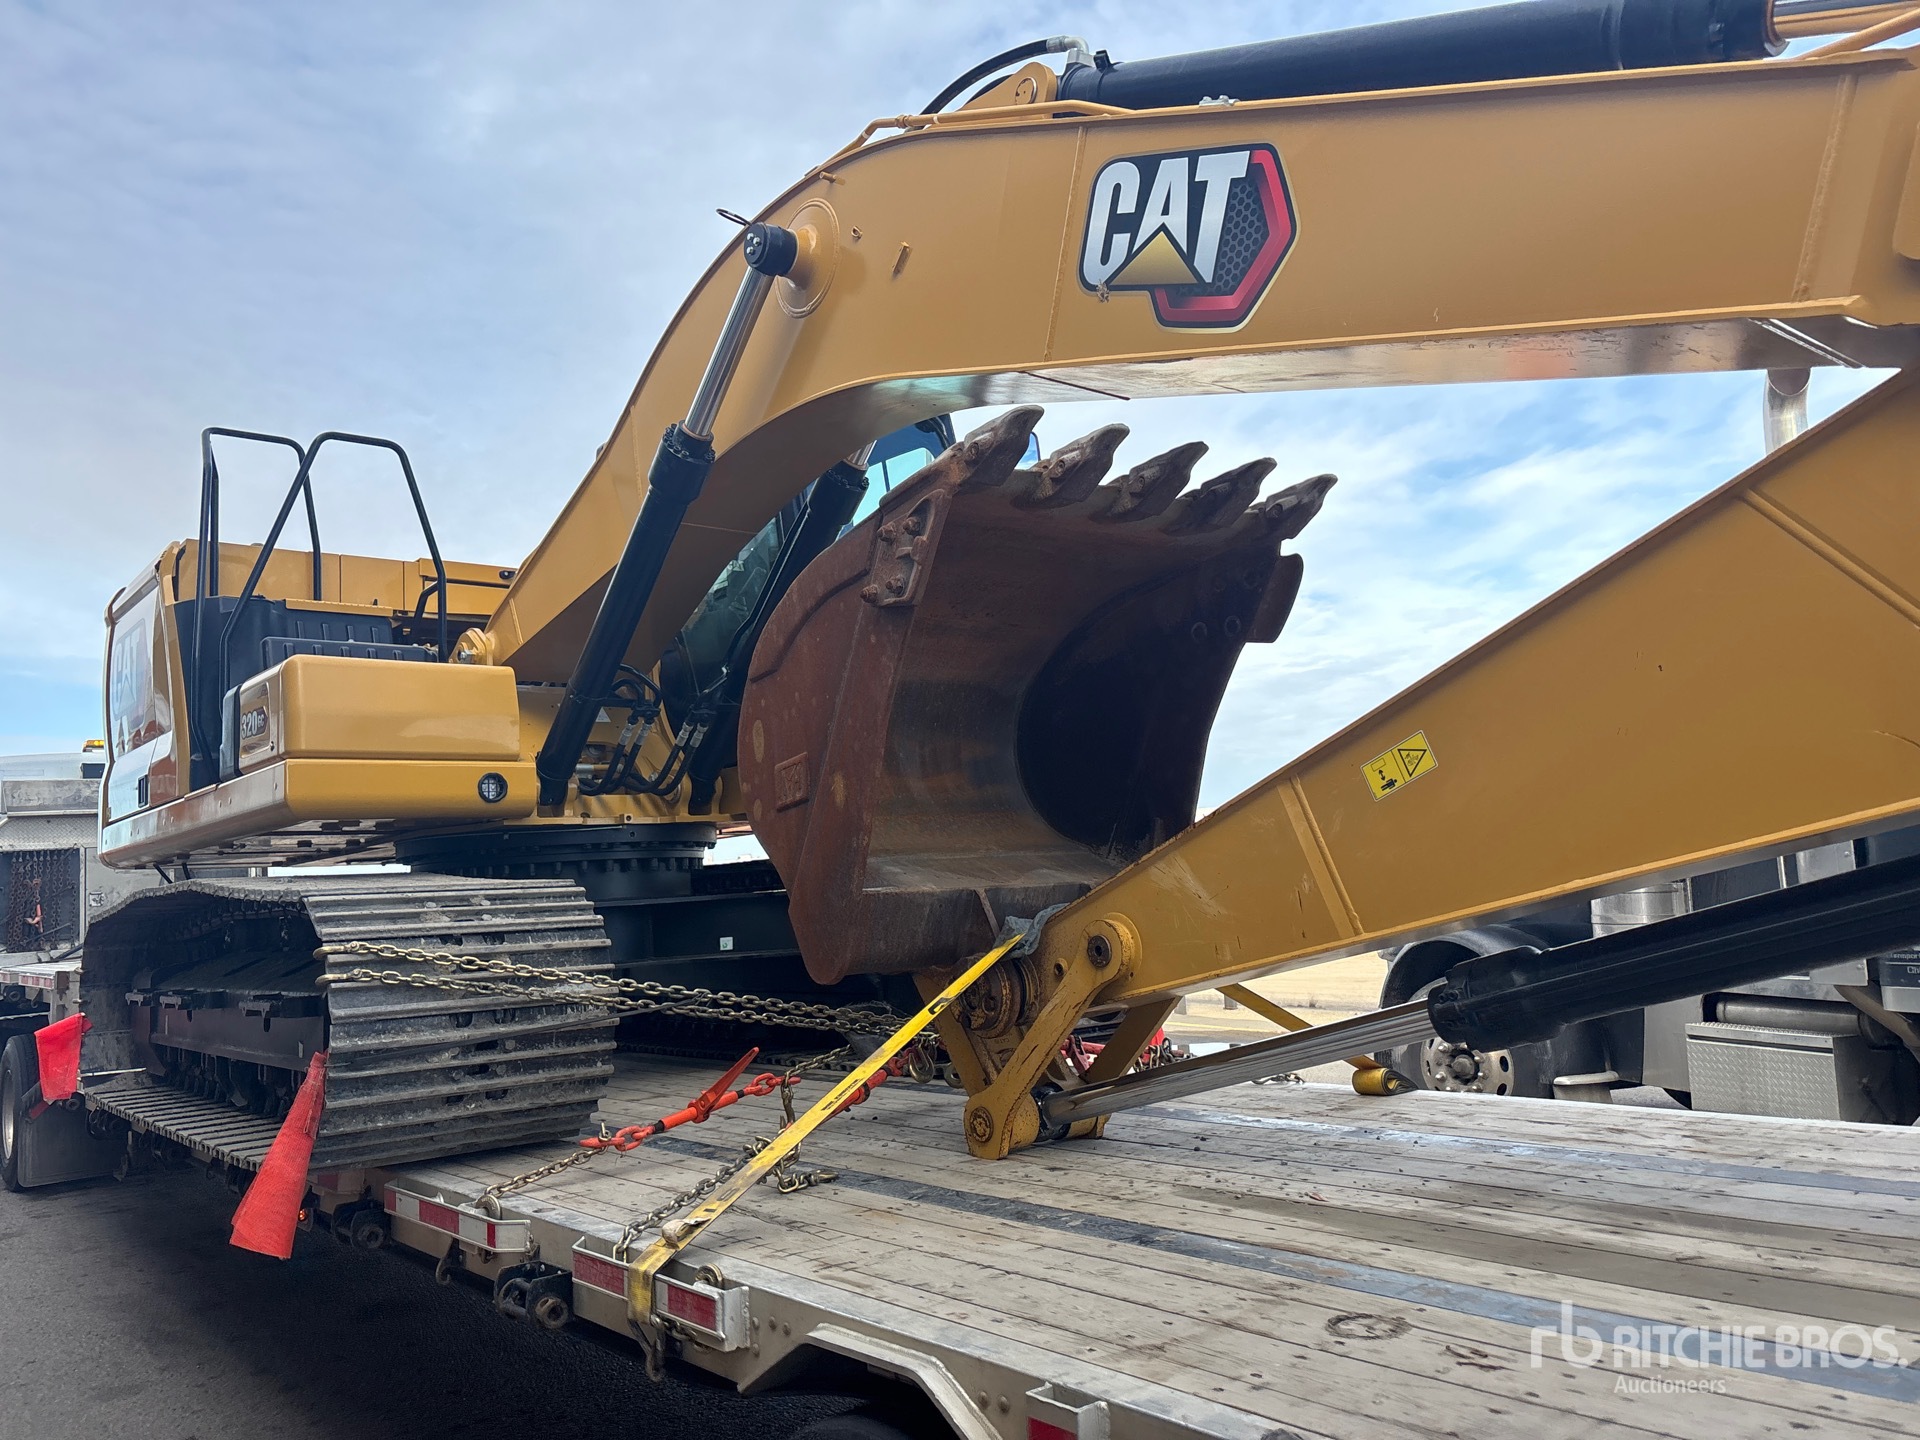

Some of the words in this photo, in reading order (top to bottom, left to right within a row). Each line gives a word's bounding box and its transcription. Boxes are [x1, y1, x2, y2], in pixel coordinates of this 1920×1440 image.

[1083, 150, 1250, 286] CAT
[113, 626, 141, 706] CAT
[241, 710, 258, 740] 320
